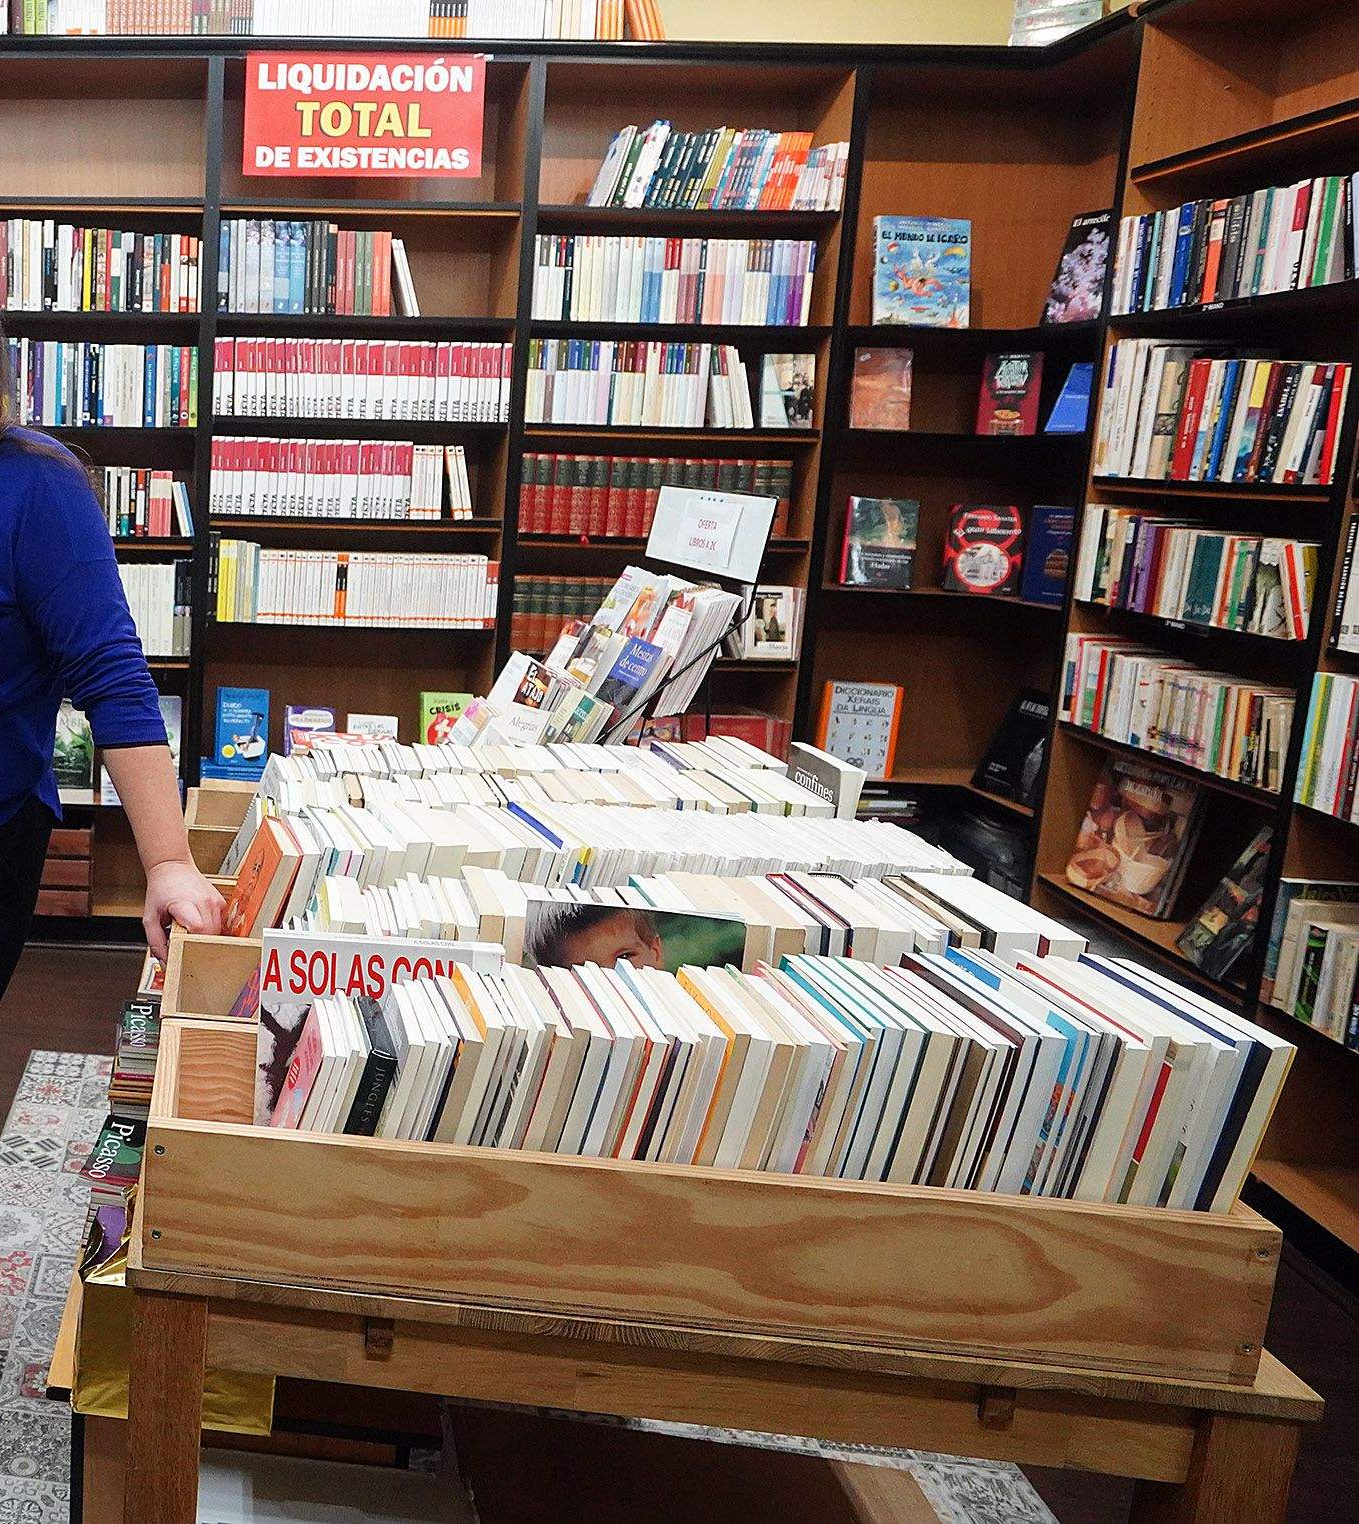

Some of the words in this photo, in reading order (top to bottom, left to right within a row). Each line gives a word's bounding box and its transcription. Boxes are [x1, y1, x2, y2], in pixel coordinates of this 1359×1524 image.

[258, 58, 473, 94] LIQUIDACIÓN
[295, 101, 432, 138] TOTAL
[255, 146, 291, 168] DE
[297, 146, 470, 170] EXISTENCIAS
[882, 230, 892, 240] EL
[698, 519, 718, 530] OFERTA
[689, 537, 705, 548] LIBROS
[521, 683, 545, 703] ATAJO
[835, 686, 894, 698] DICCIONARIO
[848, 695, 880, 705] XERAIS
[429, 703, 461, 715] CRISIS
[795, 771, 834, 803] confines
[263, 949, 283, 992] A
[289, 950, 385, 1000] SOLAS
[361, 1066, 386, 1122] JUNGLES
[89, 1121, 135, 1179] Picasso
